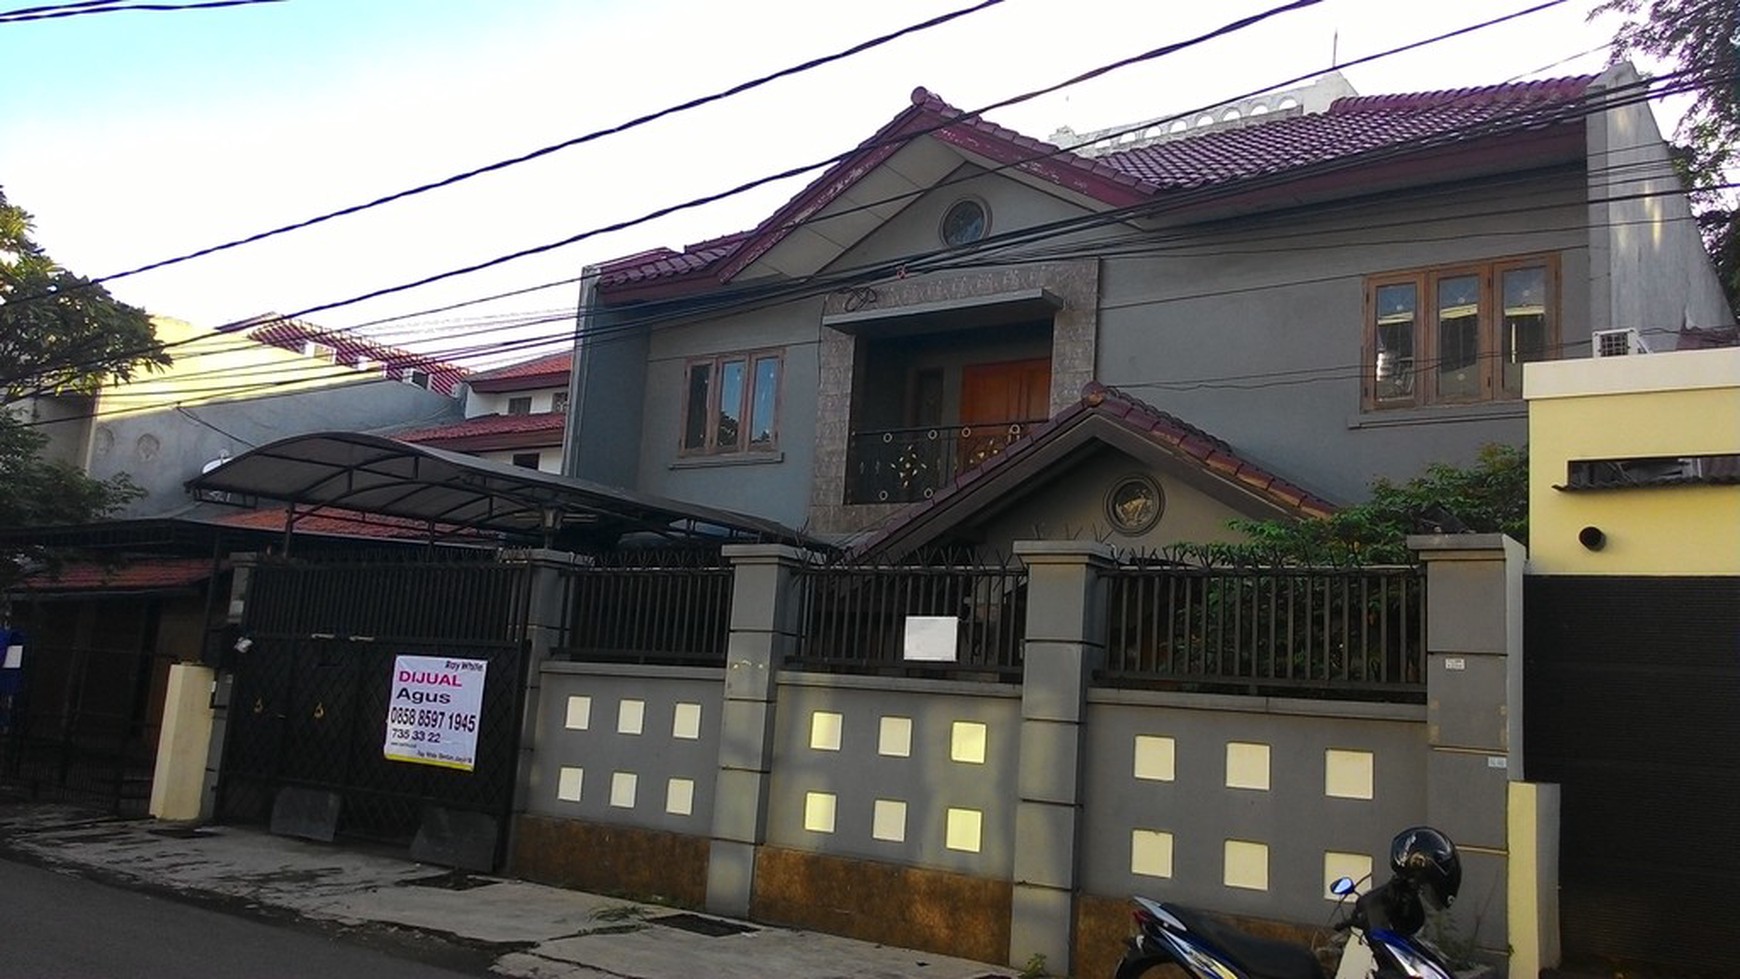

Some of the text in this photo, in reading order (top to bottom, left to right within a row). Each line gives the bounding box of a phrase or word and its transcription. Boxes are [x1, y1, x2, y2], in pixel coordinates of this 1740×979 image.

[445, 660, 483, 672] Ray White
[399, 670, 462, 687] DIJUAL
[396, 687, 451, 704] Agus
[390, 706, 476, 733] 0858 8597 1945
[391, 728, 441, 743] 735 33 22
